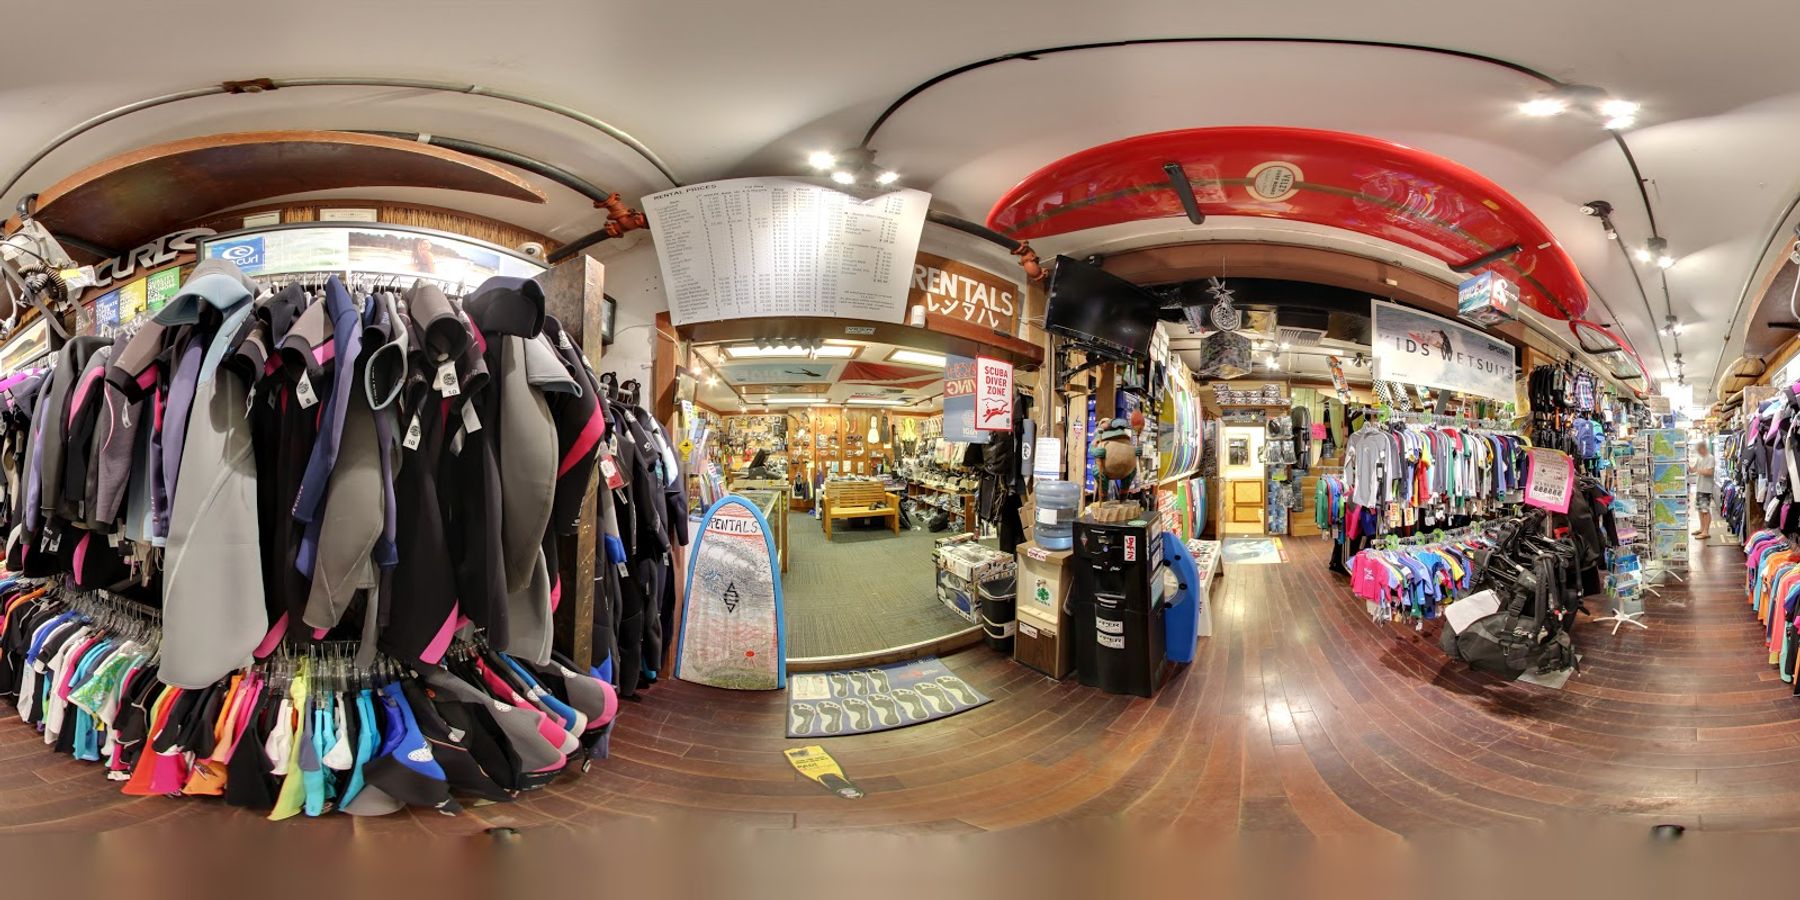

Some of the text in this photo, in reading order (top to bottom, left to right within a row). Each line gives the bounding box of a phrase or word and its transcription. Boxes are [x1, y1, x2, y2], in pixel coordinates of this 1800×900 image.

[654, 191, 682, 200] RENTAL
[686, 184, 717, 193] PRICES
[910, 264, 1013, 316] RENTALS
[926, 293, 998, 327] レンタル
[1441, 346, 1513, 379] WETSUITS
[984, 366, 1008, 378] SCUBA
[985, 376, 1007, 387] DIVER
[987, 386, 1006, 397] ZONE
[708, 518, 758, 533] RENTALS
